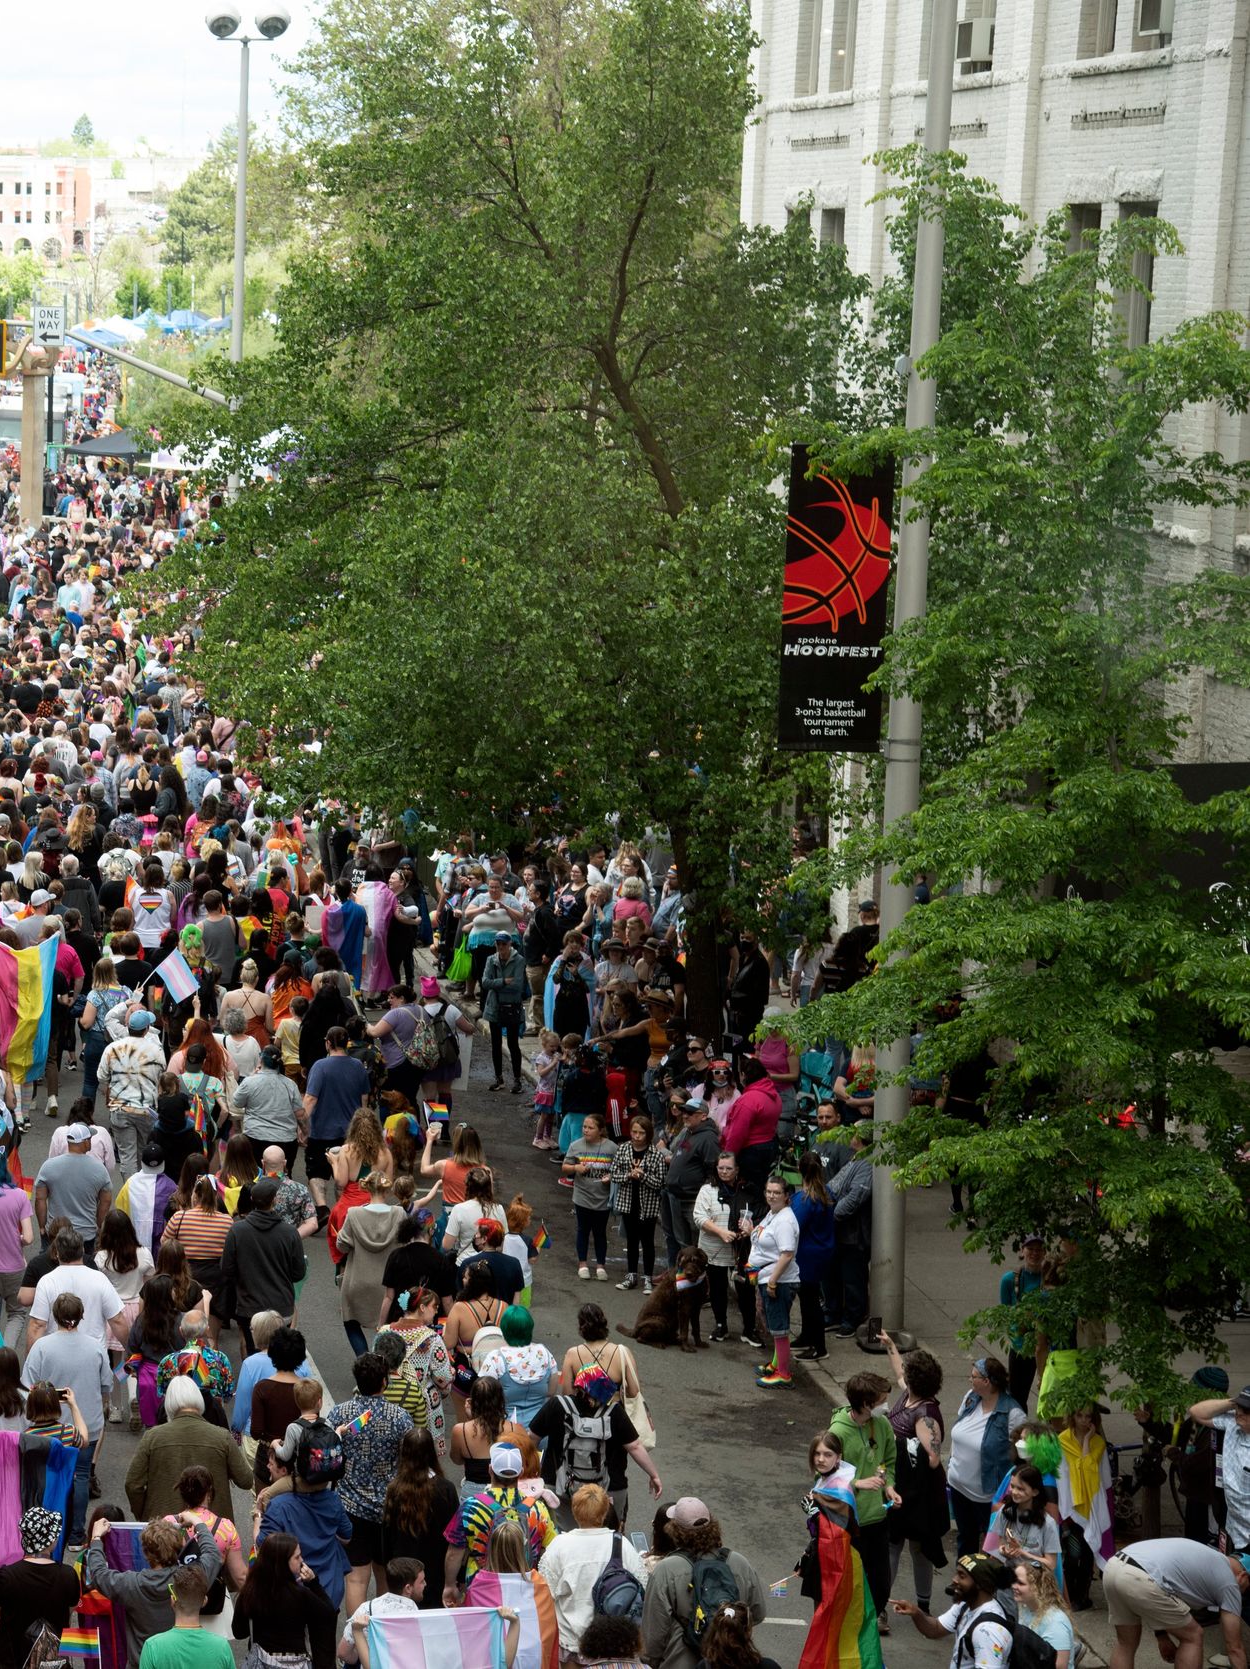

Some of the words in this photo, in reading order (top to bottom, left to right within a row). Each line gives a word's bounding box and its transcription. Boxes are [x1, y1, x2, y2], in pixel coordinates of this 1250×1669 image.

[39, 309, 60, 319] ONE
[38, 320, 60, 330] WAY
[797, 636, 837, 645] spokane
[784, 644, 882, 658] HOOPFEST
[807, 698, 824, 707] The
[825, 698, 855, 709] largest
[823, 707, 866, 717] basketball
[803, 718, 854, 727] tournament
[809, 728, 822, 736] on
[823, 727, 849, 736] Earth.
